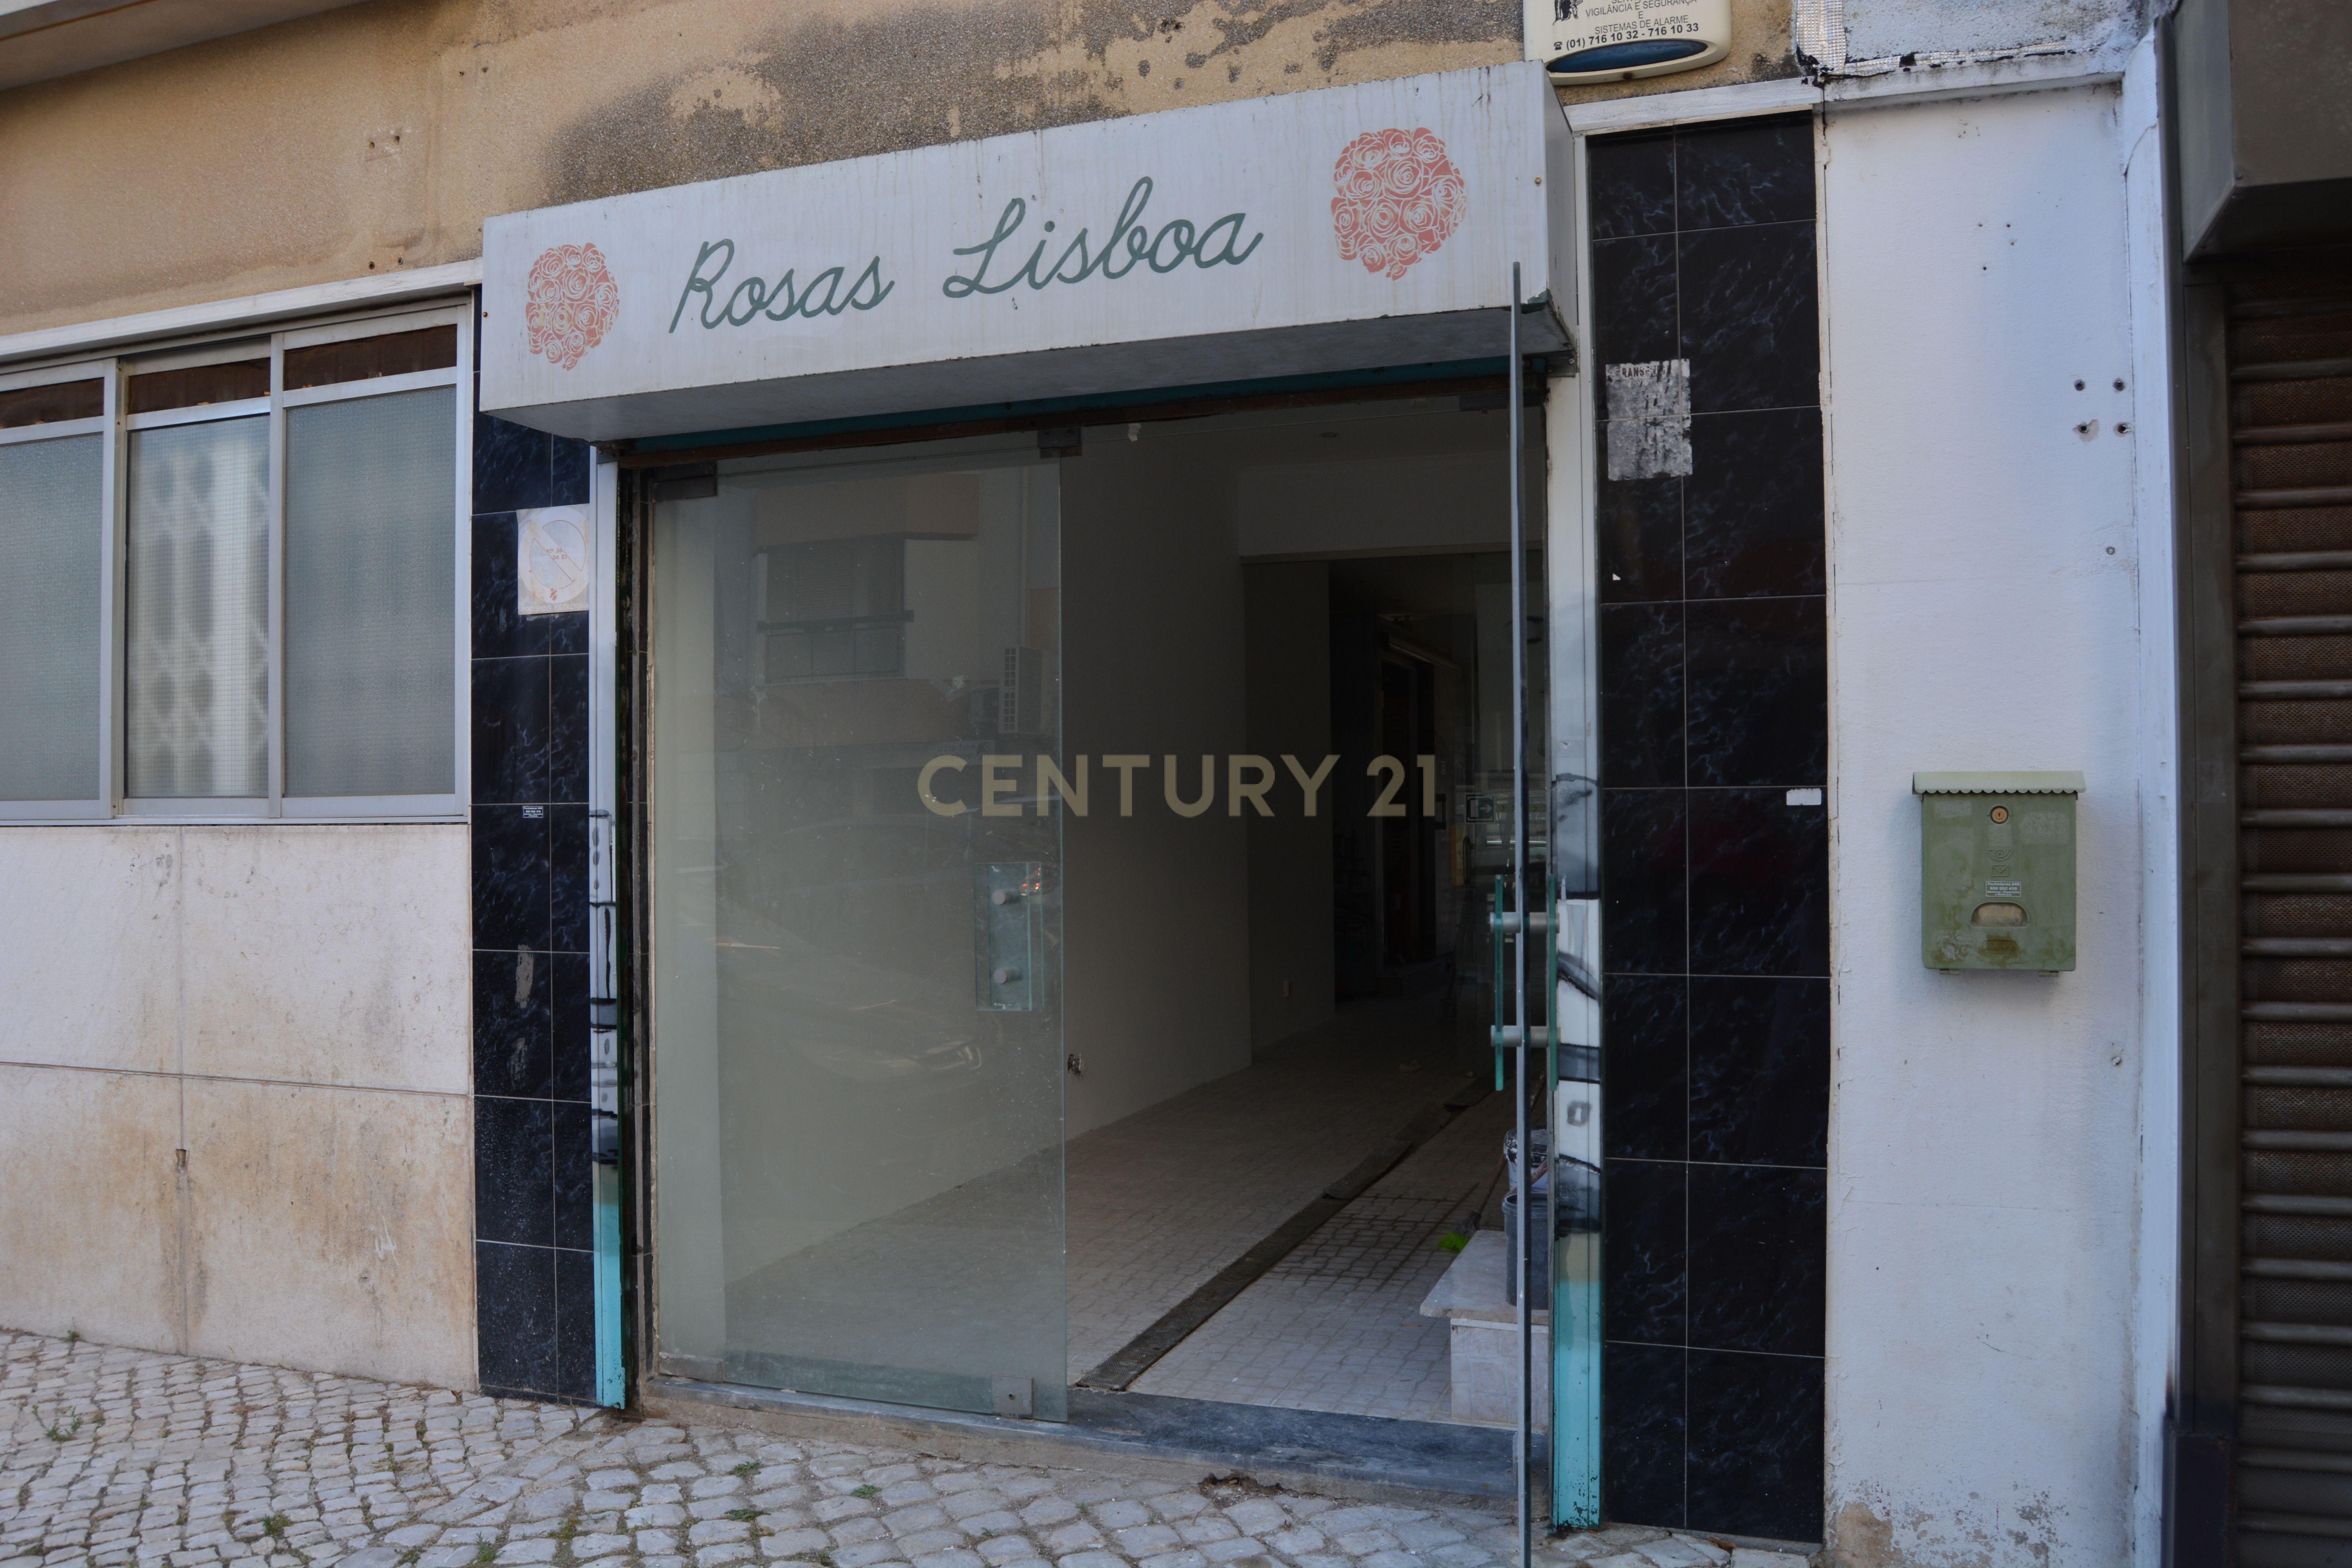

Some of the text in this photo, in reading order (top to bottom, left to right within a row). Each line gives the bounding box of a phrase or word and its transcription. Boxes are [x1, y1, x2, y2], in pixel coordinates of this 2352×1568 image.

[1586, 3, 1633, 16] VIGILÂNCIA
[1595, 15, 1689, 34] SISTEMAS DE ALARME
[1566, 38, 1585, 51] (01)
[1589, 34, 1607, 45] 716
[1611, 32, 1622, 42] 10
[1626, 30, 1638, 39] 32
[1648, 26, 1667, 36] 716
[1671, 25, 1682, 34] 10
[1686, 23, 1699, 32] 33
[668, 176, 1264, 333] Rosas Lisboa
